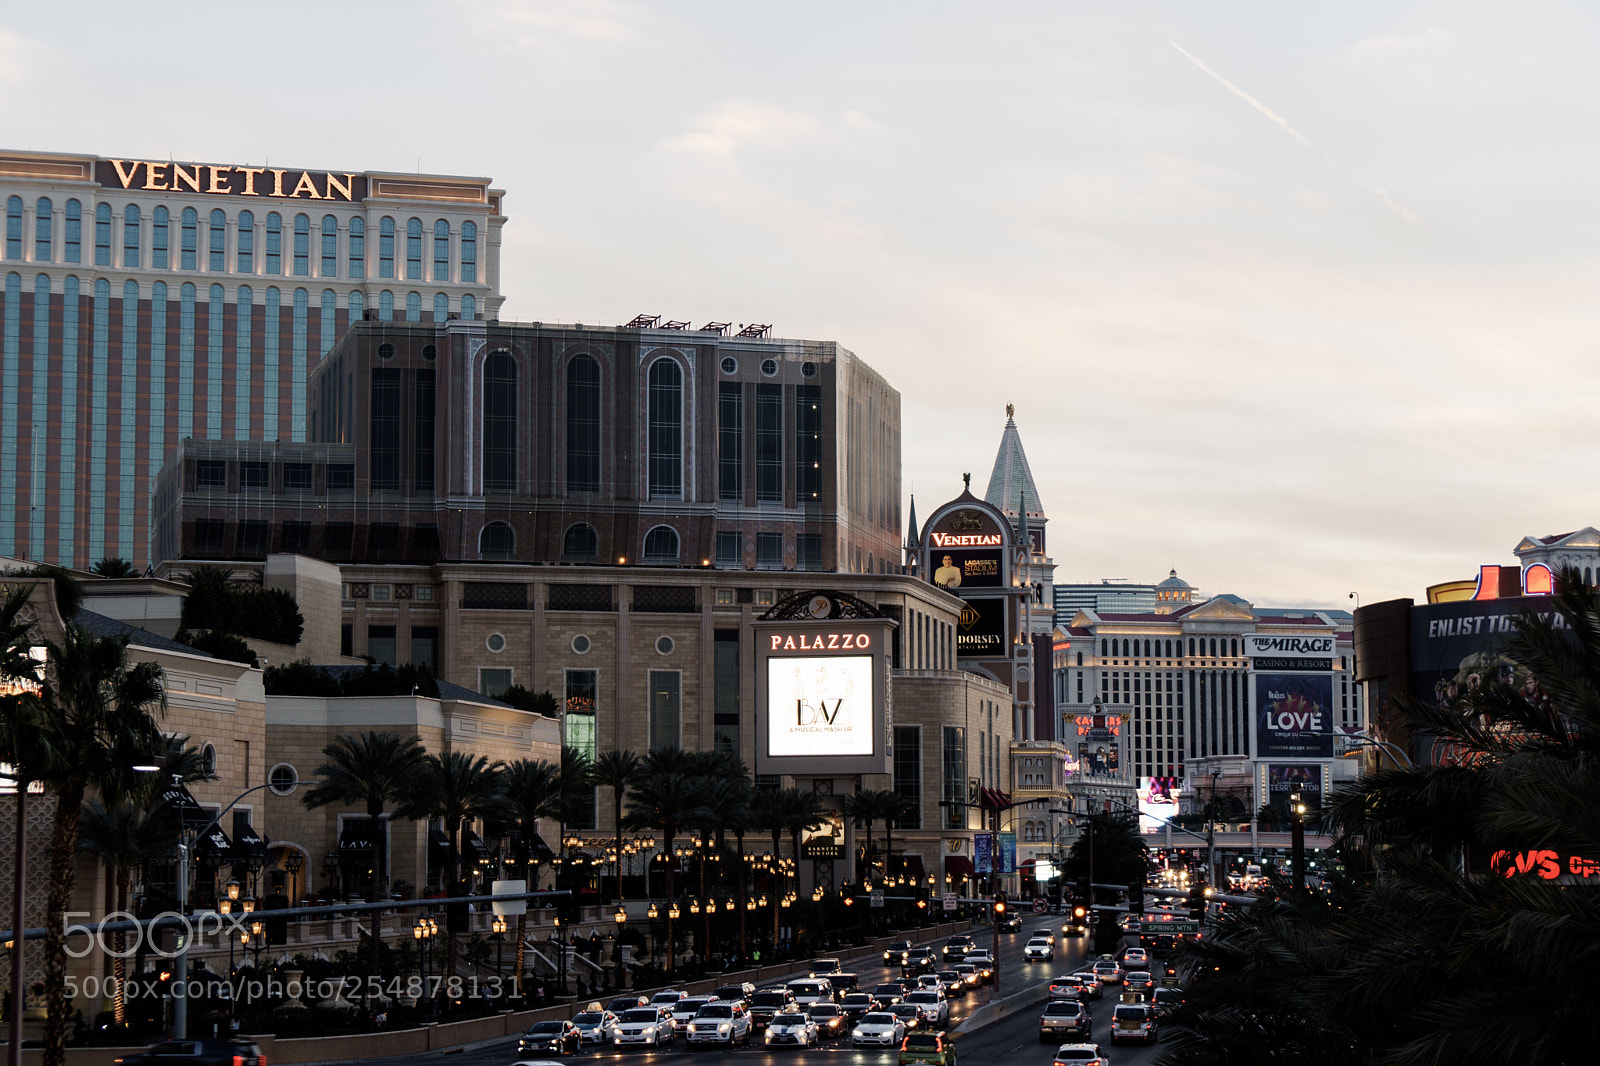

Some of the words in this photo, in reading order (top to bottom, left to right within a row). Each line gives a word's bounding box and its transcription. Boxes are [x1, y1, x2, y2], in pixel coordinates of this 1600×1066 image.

[108, 158, 356, 202] VENETIAN
[931, 532, 1002, 547] VENETIAN
[1428, 616, 1485, 638] ENLIST
[770, 633, 871, 650] PALAZZO
[958, 635, 1001, 644] DORSEY
[1252, 637, 1270, 646] THE
[1257, 638, 1333, 653] MIRAGE
[1255, 660, 1288, 668] CASINO
[1297, 660, 1331, 669] RESORT
[1266, 711, 1323, 731] LOVE
[1490, 849, 1561, 880] CVS
